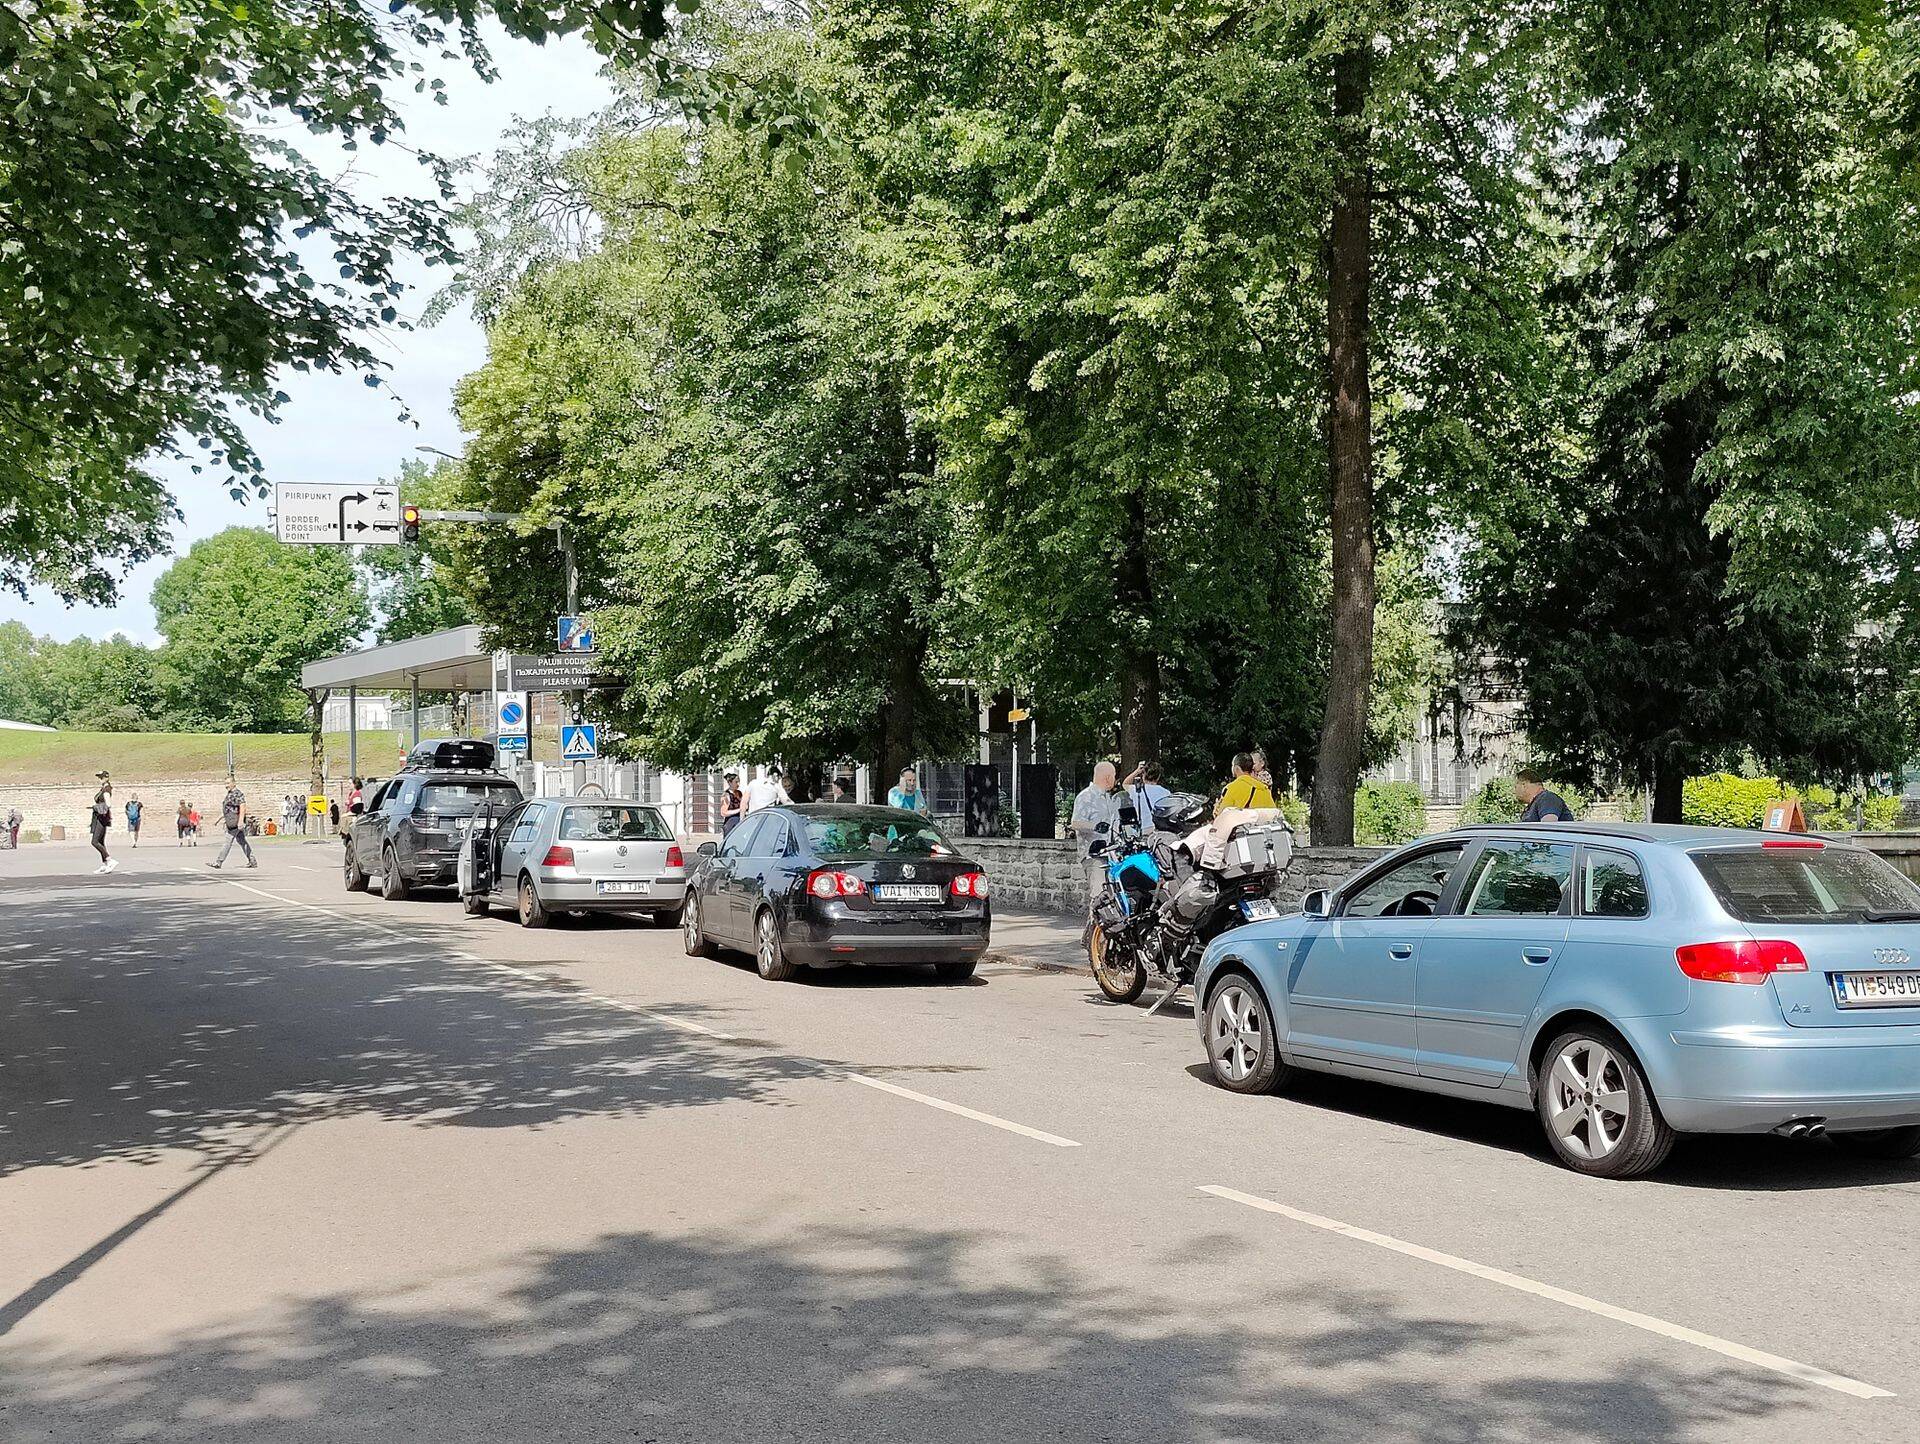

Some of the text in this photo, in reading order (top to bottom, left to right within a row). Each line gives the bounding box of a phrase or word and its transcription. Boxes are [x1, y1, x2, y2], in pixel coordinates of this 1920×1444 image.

[285, 492, 332, 500] PIIRIPUNKT
[285, 515, 320, 523] BORDER
[538, 658, 562, 666] PALUN
[543, 677, 590, 686] PLEASE WAIT
[607, 882, 622, 891] 283
[882, 885, 938, 897] VAI NK 88
[1849, 976, 1867, 996] VI
